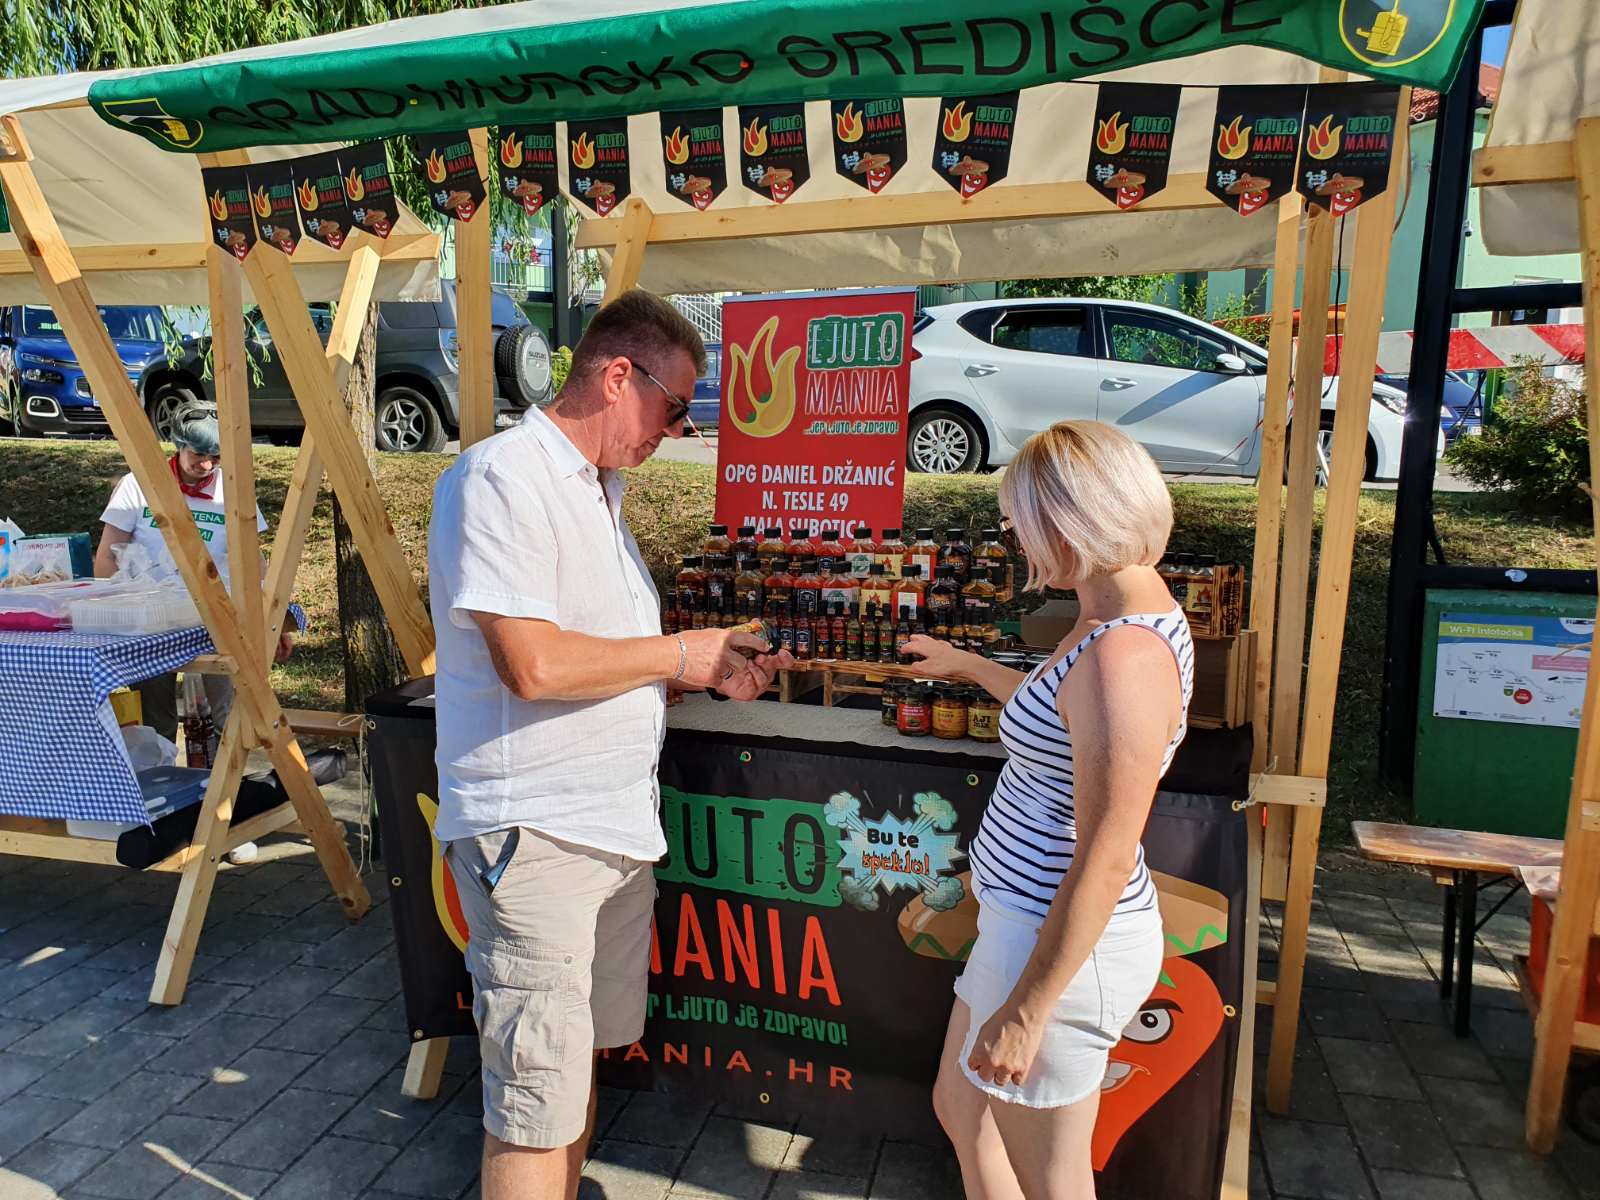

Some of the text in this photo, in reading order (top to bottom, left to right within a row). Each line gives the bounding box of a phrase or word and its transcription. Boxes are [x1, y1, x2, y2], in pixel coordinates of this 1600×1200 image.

[867, 113, 902, 132] MANIA
[974, 123, 1009, 138] MANIA
[1129, 134, 1168, 150] MANIA
[1253, 136, 1294, 152] MANIA
[1345, 134, 1388, 151] MANIA
[804, 370, 899, 415] MANIA
[725, 459, 896, 487] OPG DANIEL DRŽANIĆ
[762, 490, 849, 513] N. TESLE 49
[866, 828, 920, 849] Bu te
[862, 850, 930, 877] speklo!
[734, 1003, 759, 1029] je
